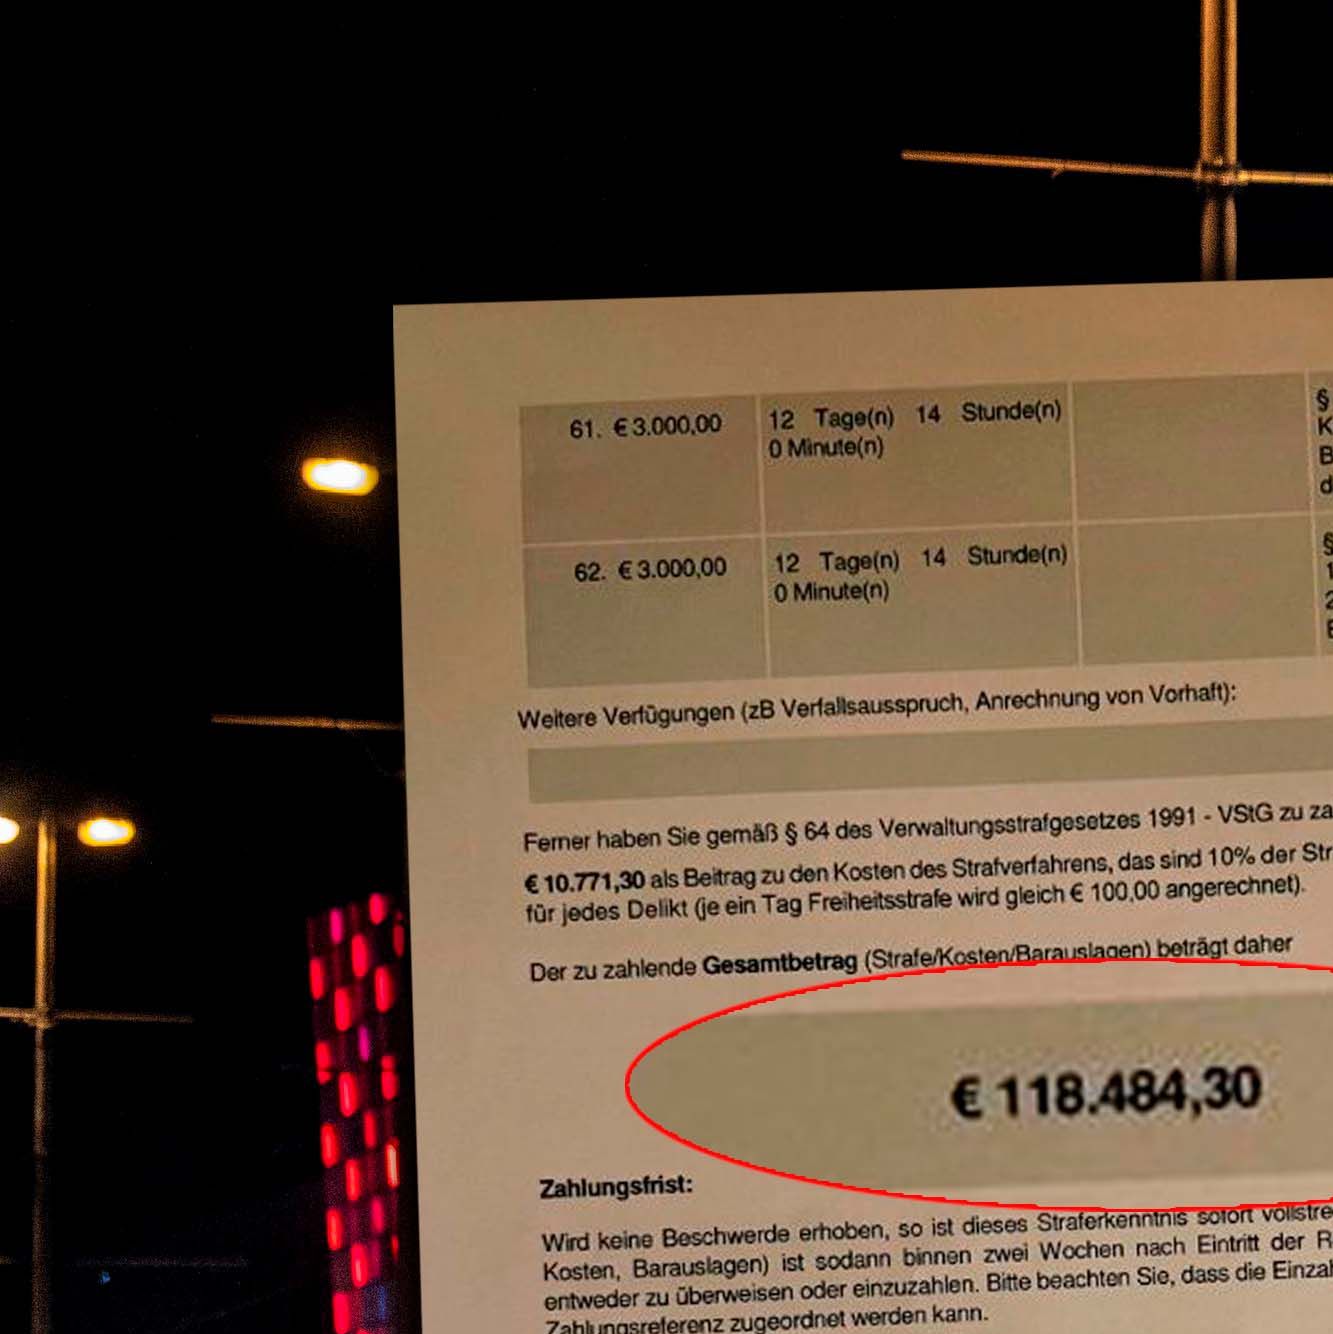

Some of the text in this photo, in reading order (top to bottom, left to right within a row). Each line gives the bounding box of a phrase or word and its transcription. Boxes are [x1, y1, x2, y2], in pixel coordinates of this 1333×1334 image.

[769, 398, 1062, 432] 12 Tage(n) 14 Stunde(n)
[1315, 387, 1330, 412] §
[570, 419, 601, 438] 61.
[768, 434, 884, 460] 0 Minute(n)
[574, 561, 606, 582] 62.
[775, 543, 1067, 575] 12 Tage(n) 14 Stunde(n)
[773, 579, 889, 604] 0 Minute(n)
[517, 681, 1236, 730] Weitere Verfügungen (zB Verfallsausspruch, Anrechnung von Vorhaft):
[523, 831, 591, 853] Ferner
[596, 829, 662, 849] haben
[667, 825, 700, 847] Sie
[706, 822, 779, 850] gemäß
[784, 821, 798, 847] §
[804, 821, 830, 841] 64
[835, 820, 872, 840] des
[878, 811, 1141, 840] Verwaltungsstrafgesetzes
[1148, 806, 1195, 828] 1991
[1217, 802, 1274, 824] VStG
[1279, 806, 1303, 822] zu
[543, 870, 646, 894] 10.771,30
[650, 868, 679, 889] als
[683, 866, 757, 890] Beitrag
[760, 868, 785, 885] zu
[788, 863, 829, 884] den
[833, 861, 906, 881] Kosten
[910, 860, 947, 879] des
[952, 853, 1113, 878] Strafverfahrens,
[1117, 851, 1155, 871] das
[1159, 848, 1202, 869] sind
[1207, 845, 1256, 867] 10%
[1260, 844, 1297, 864] der
[530, 962, 567, 982] Der
[572, 964, 597, 980] zu
[602, 956, 697, 980] zahlende
[701, 951, 858, 975] Gesamtbetrag
[1156, 936, 1228, 957] beträgt
[1233, 934, 1293, 955] daher
[996, 1064, 1263, 1119] 118.484,30
[539, 1174, 693, 1202] Zahlungsfrist:
[543, 1261, 621, 1282] Kosten,
[632, 1254, 769, 1280] Barauslagen)
[781, 1253, 805, 1272] ist
[815, 1248, 891, 1271] sodann
[902, 1246, 972, 1267] binnen
[983, 1242, 1029, 1264] zwei
[1038, 1239, 1125, 1261] Wochen
[1136, 1236, 1186, 1257] nach
[1197, 1233, 1260, 1254] Eintritt
[1270, 1231, 1305, 1252] der
[850, 1306, 927, 1327] werden
[932, 1303, 989, 1323] kann.
